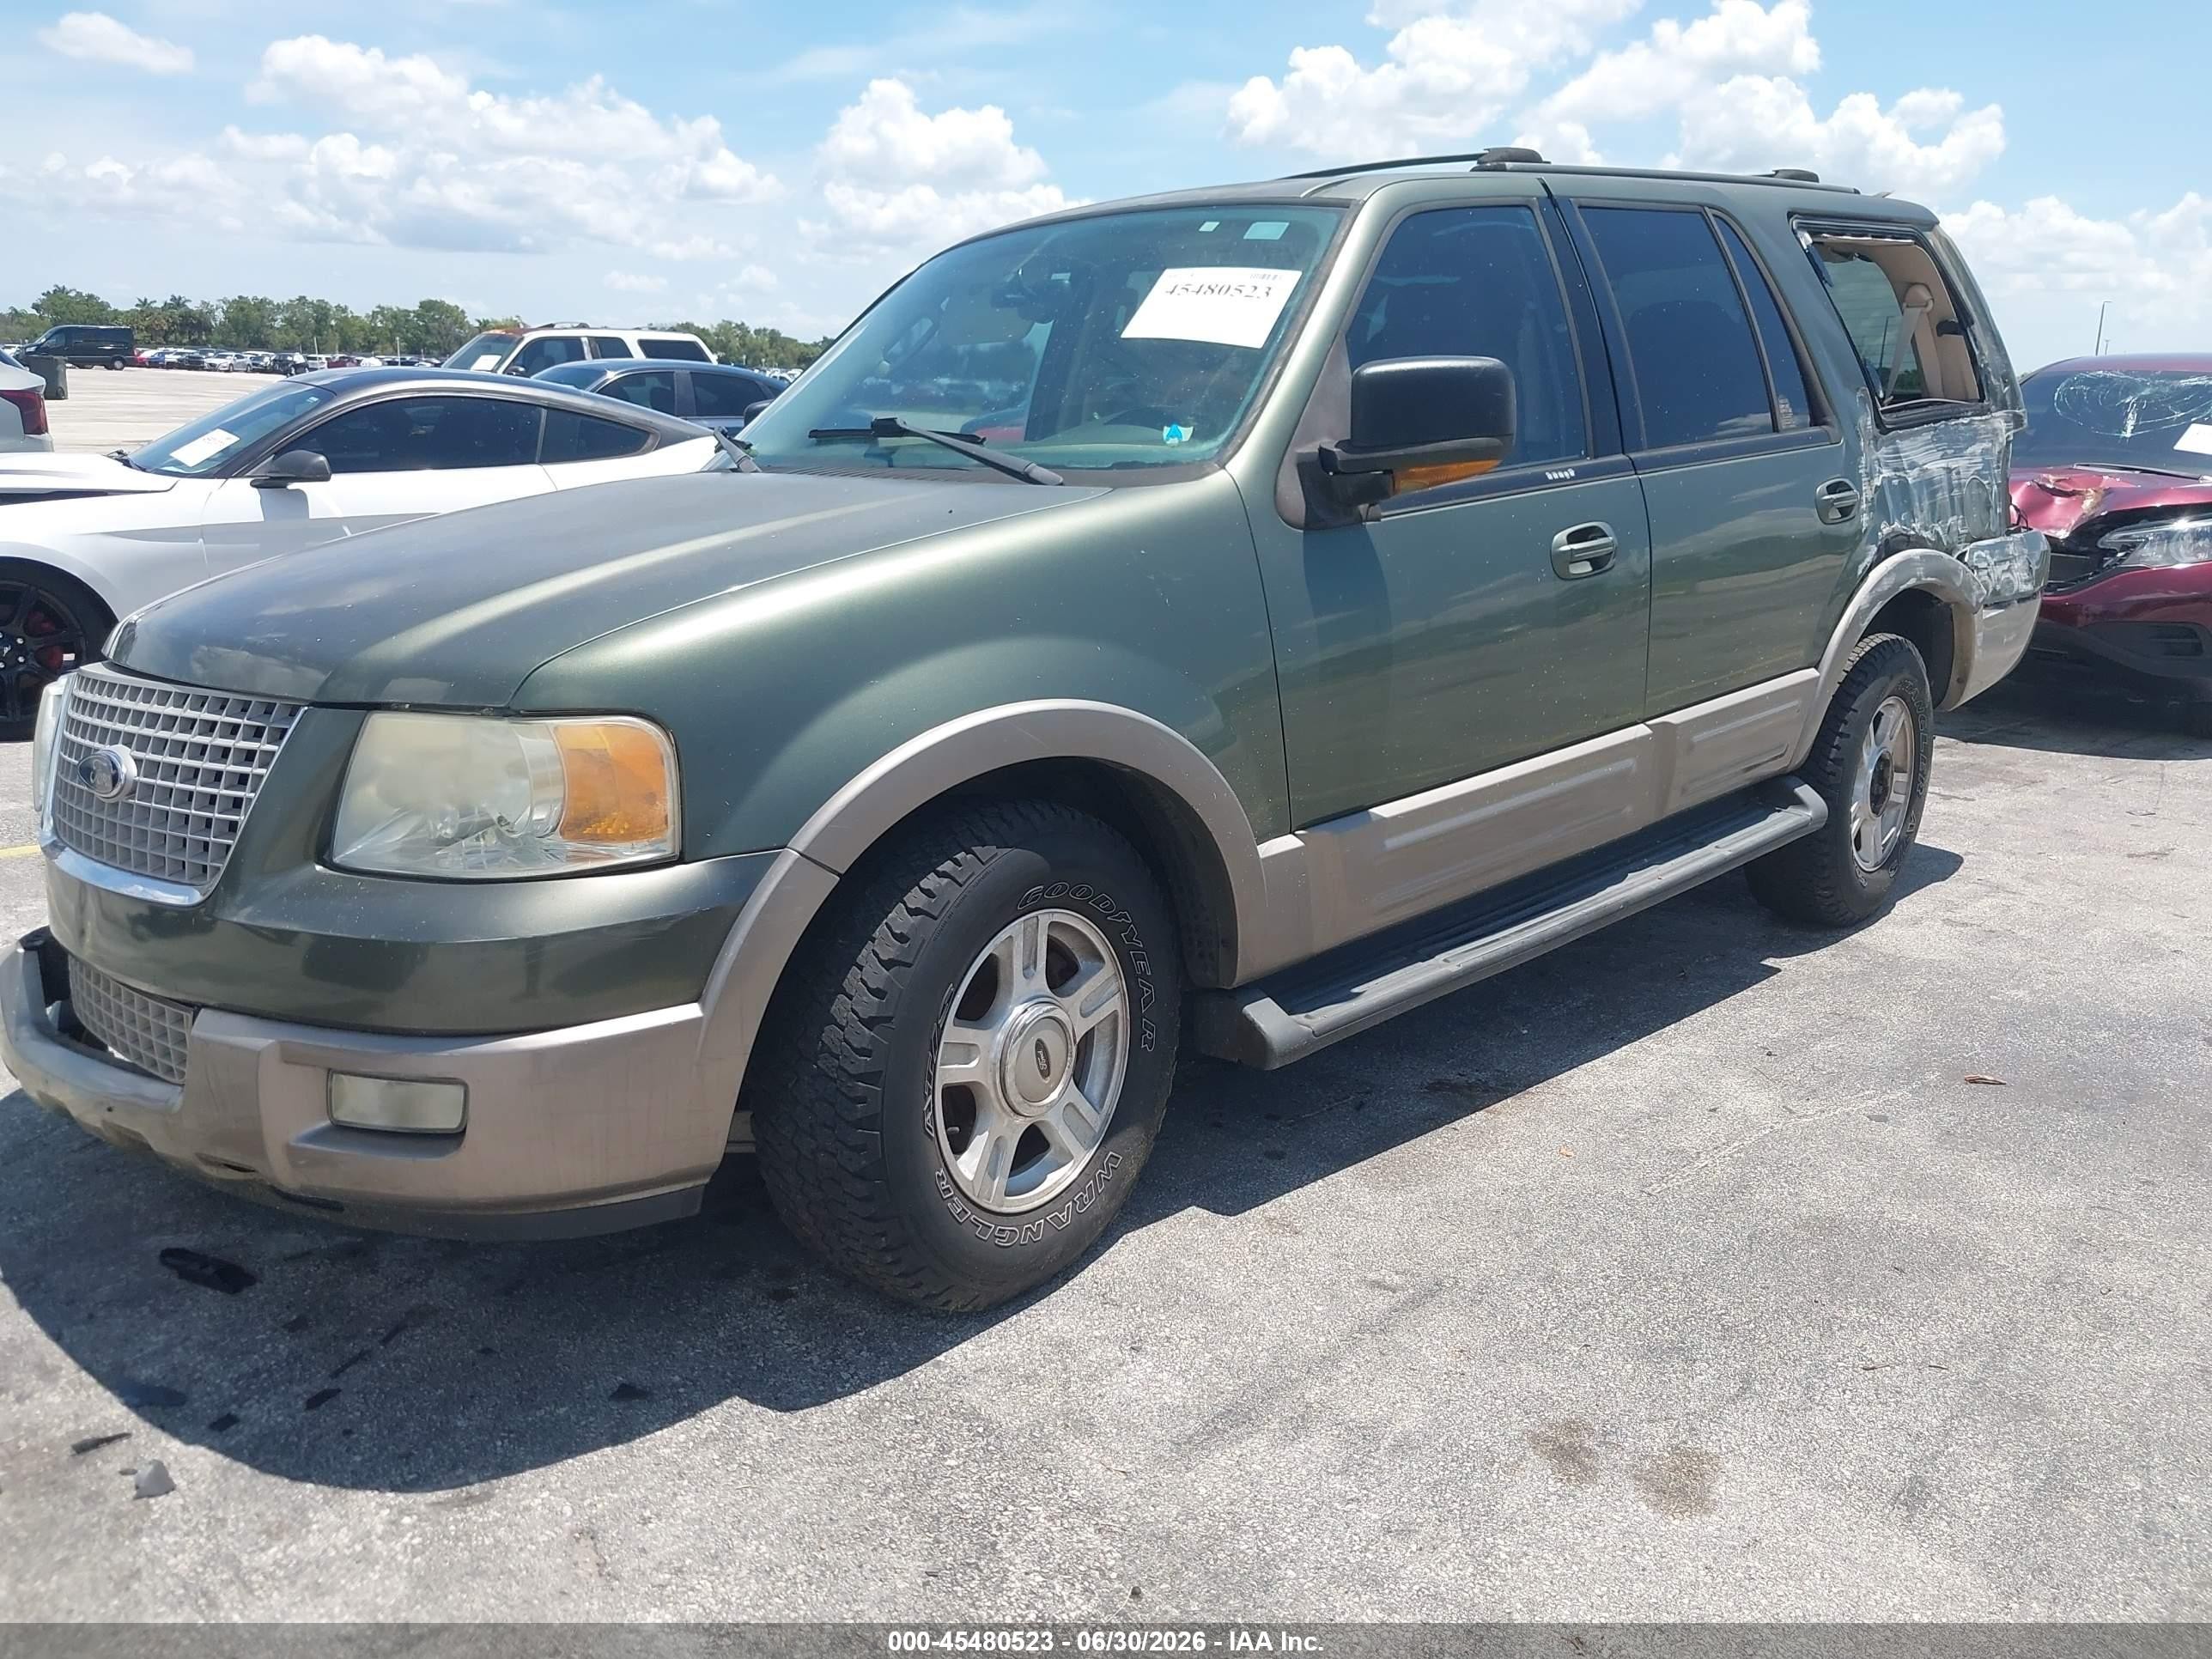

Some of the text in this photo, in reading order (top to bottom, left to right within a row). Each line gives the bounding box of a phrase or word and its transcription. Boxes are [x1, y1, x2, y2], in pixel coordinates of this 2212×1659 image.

[1165, 283, 1273, 299] 45480523
[1018, 882, 1156, 1052] GOODYEAR
[935, 1151, 1123, 1247] WRANGLER
